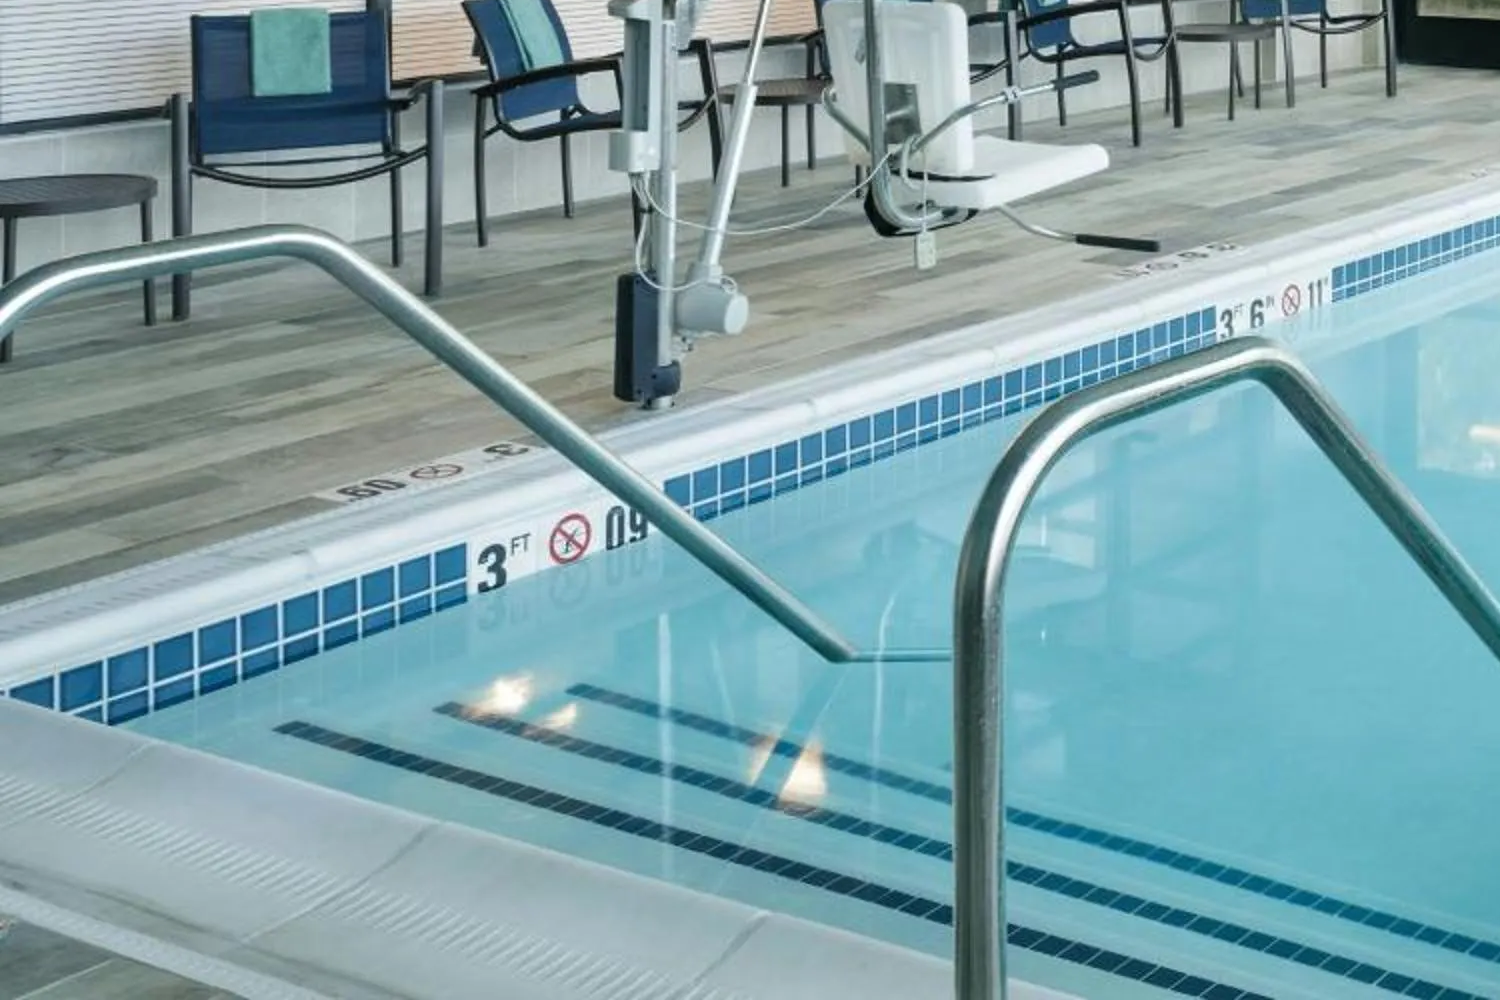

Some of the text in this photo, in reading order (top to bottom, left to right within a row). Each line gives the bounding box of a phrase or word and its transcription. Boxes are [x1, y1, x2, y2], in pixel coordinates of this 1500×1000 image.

[1219, 309, 1234, 339] 3
[1250, 298, 1265, 329] 6
[477, 543, 508, 594] 3
[510, 532, 532, 557] FT
